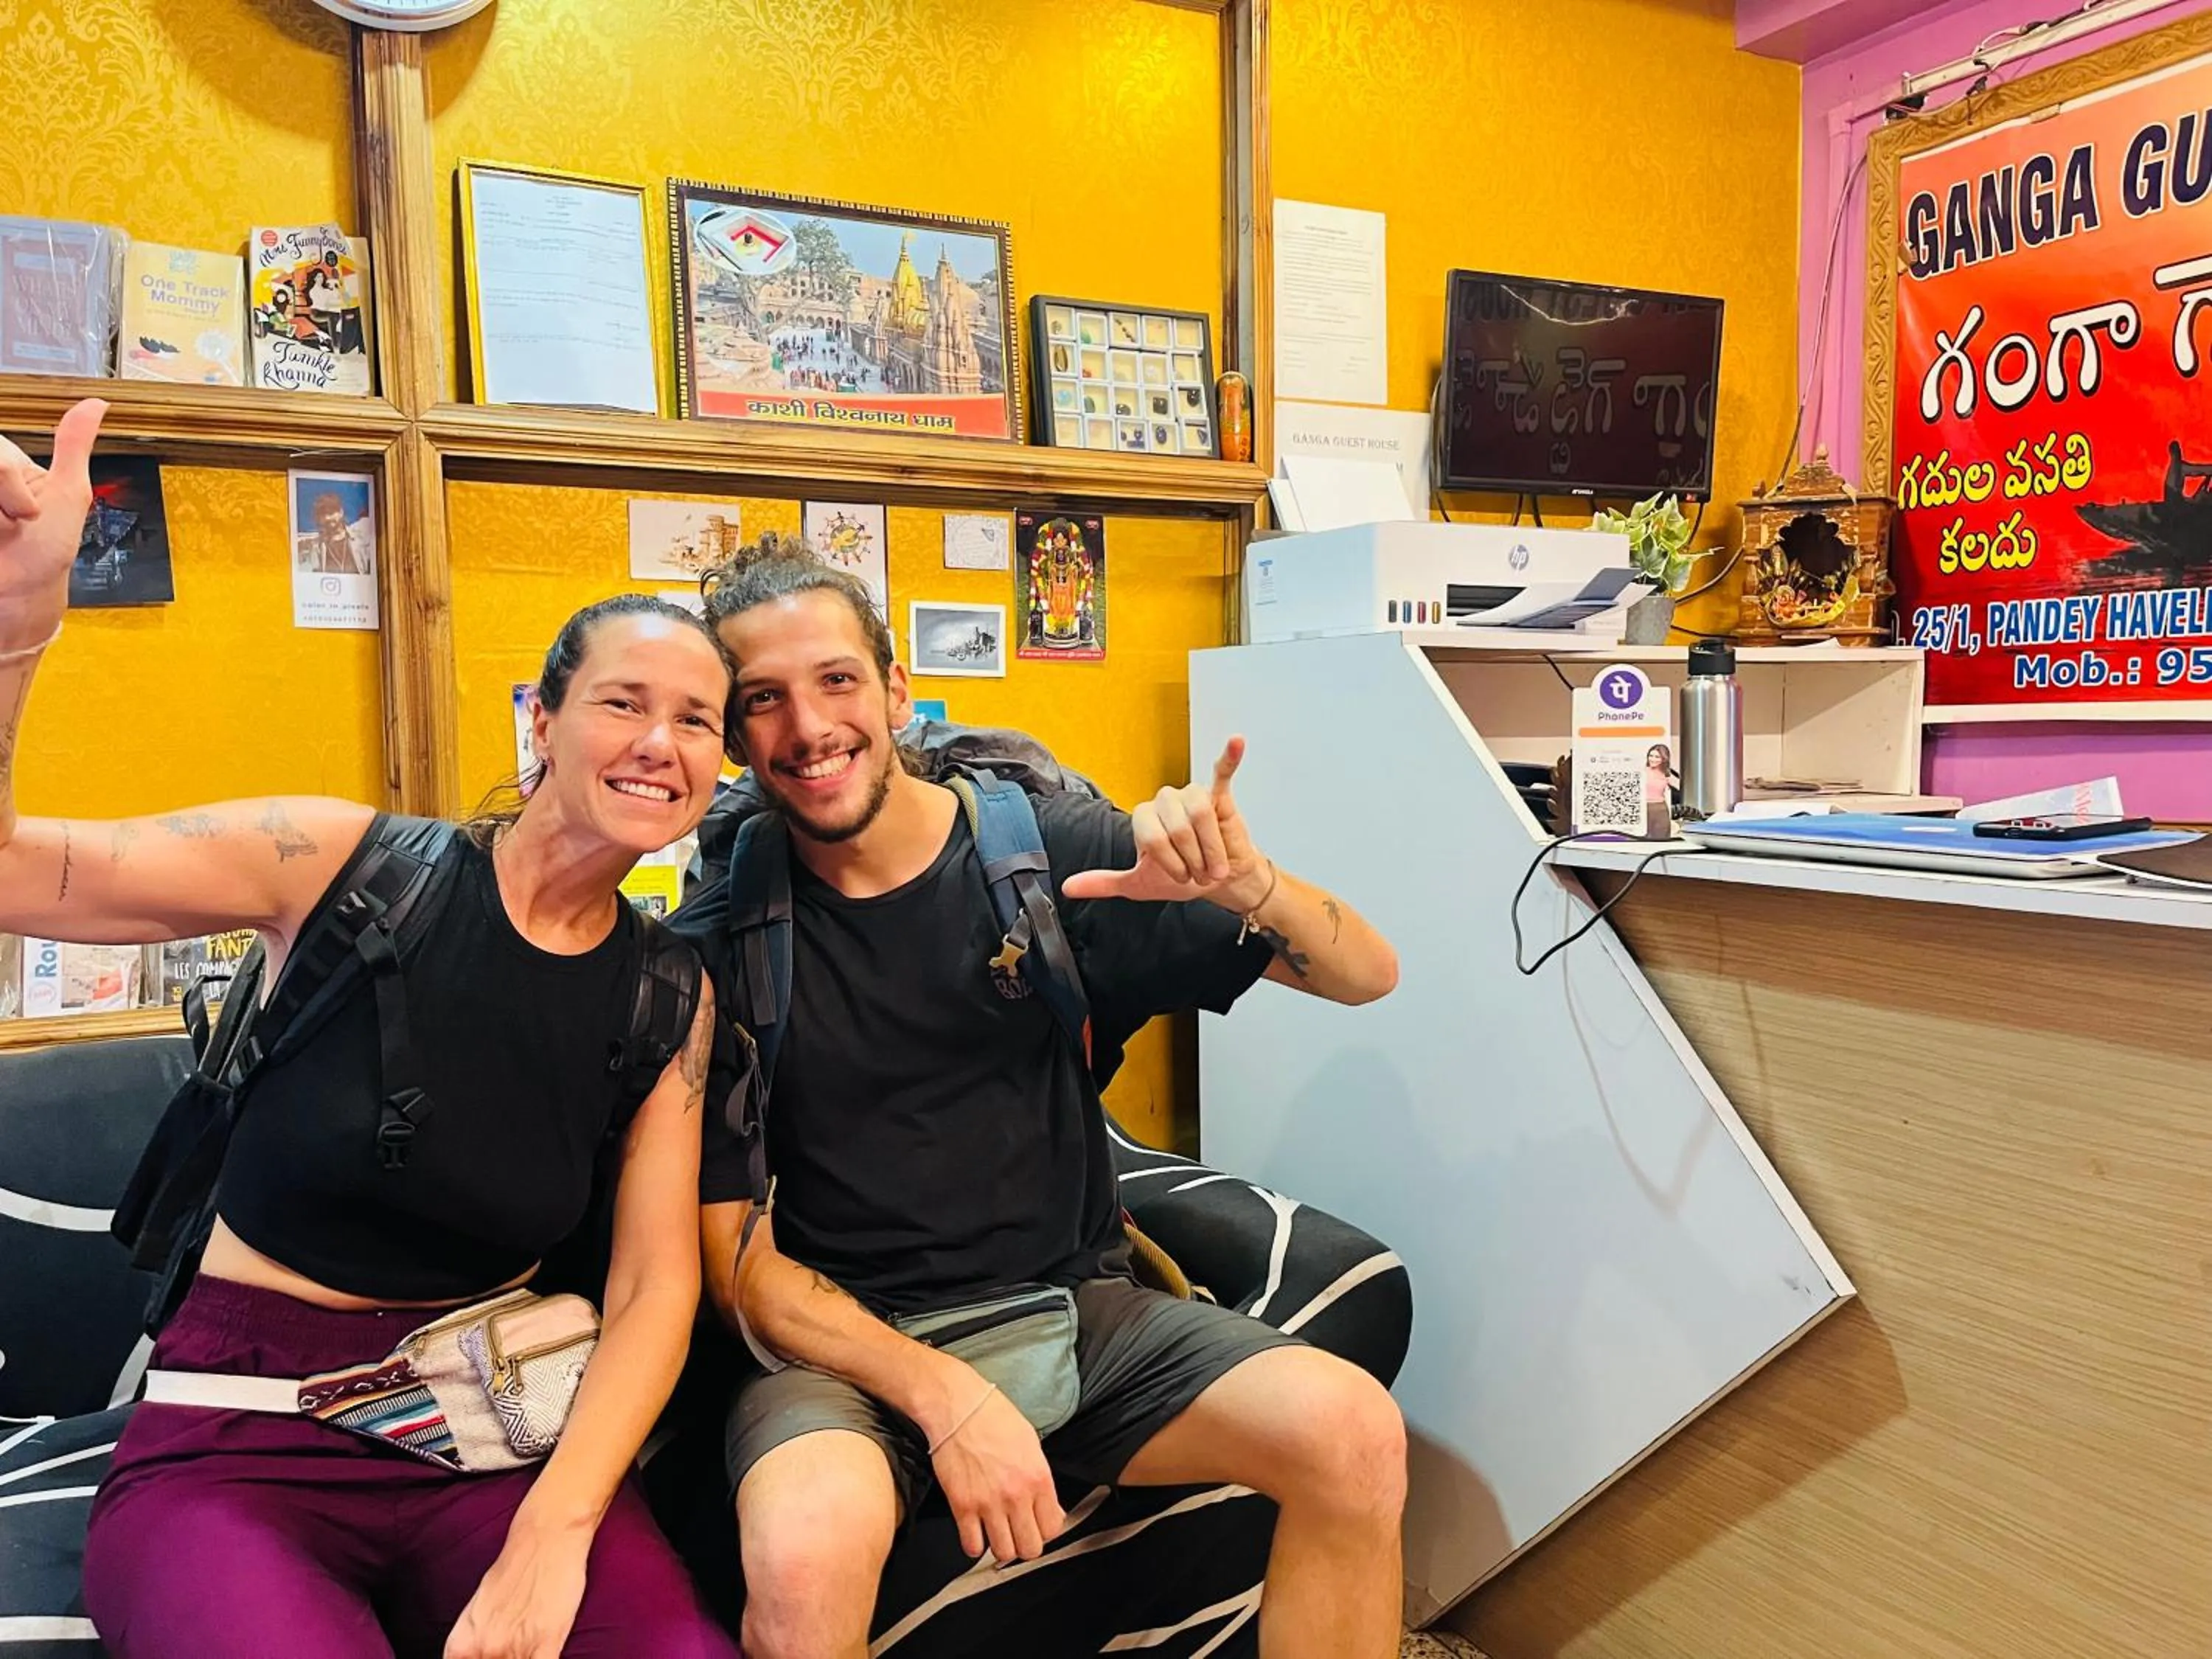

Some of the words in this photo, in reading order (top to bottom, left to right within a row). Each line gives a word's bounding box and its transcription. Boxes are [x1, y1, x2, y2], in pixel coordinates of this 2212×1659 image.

[1906, 143, 2100, 281] GANGA
[141, 274, 175, 291] One
[184, 281, 229, 299] Track
[151, 289, 220, 317] Mommy
[1919, 299, 2140, 425] గంగా
[748, 399, 805, 417] काशी
[813, 402, 905, 425] विश्वनाथ
[913, 414, 953, 429] धाम
[1332, 437, 1366, 448] GUEST
[1897, 450, 1996, 511] గదుల
[2003, 431, 2093, 499] వసతి
[1938, 510, 2039, 575] కలదు
[1913, 604, 1980, 656] 25/1,
[1987, 594, 2100, 647] PANDEY
[2157, 646, 2212, 686] 95
[1598, 712, 1644, 721] PhonePe
[174, 962, 191, 981] LES
